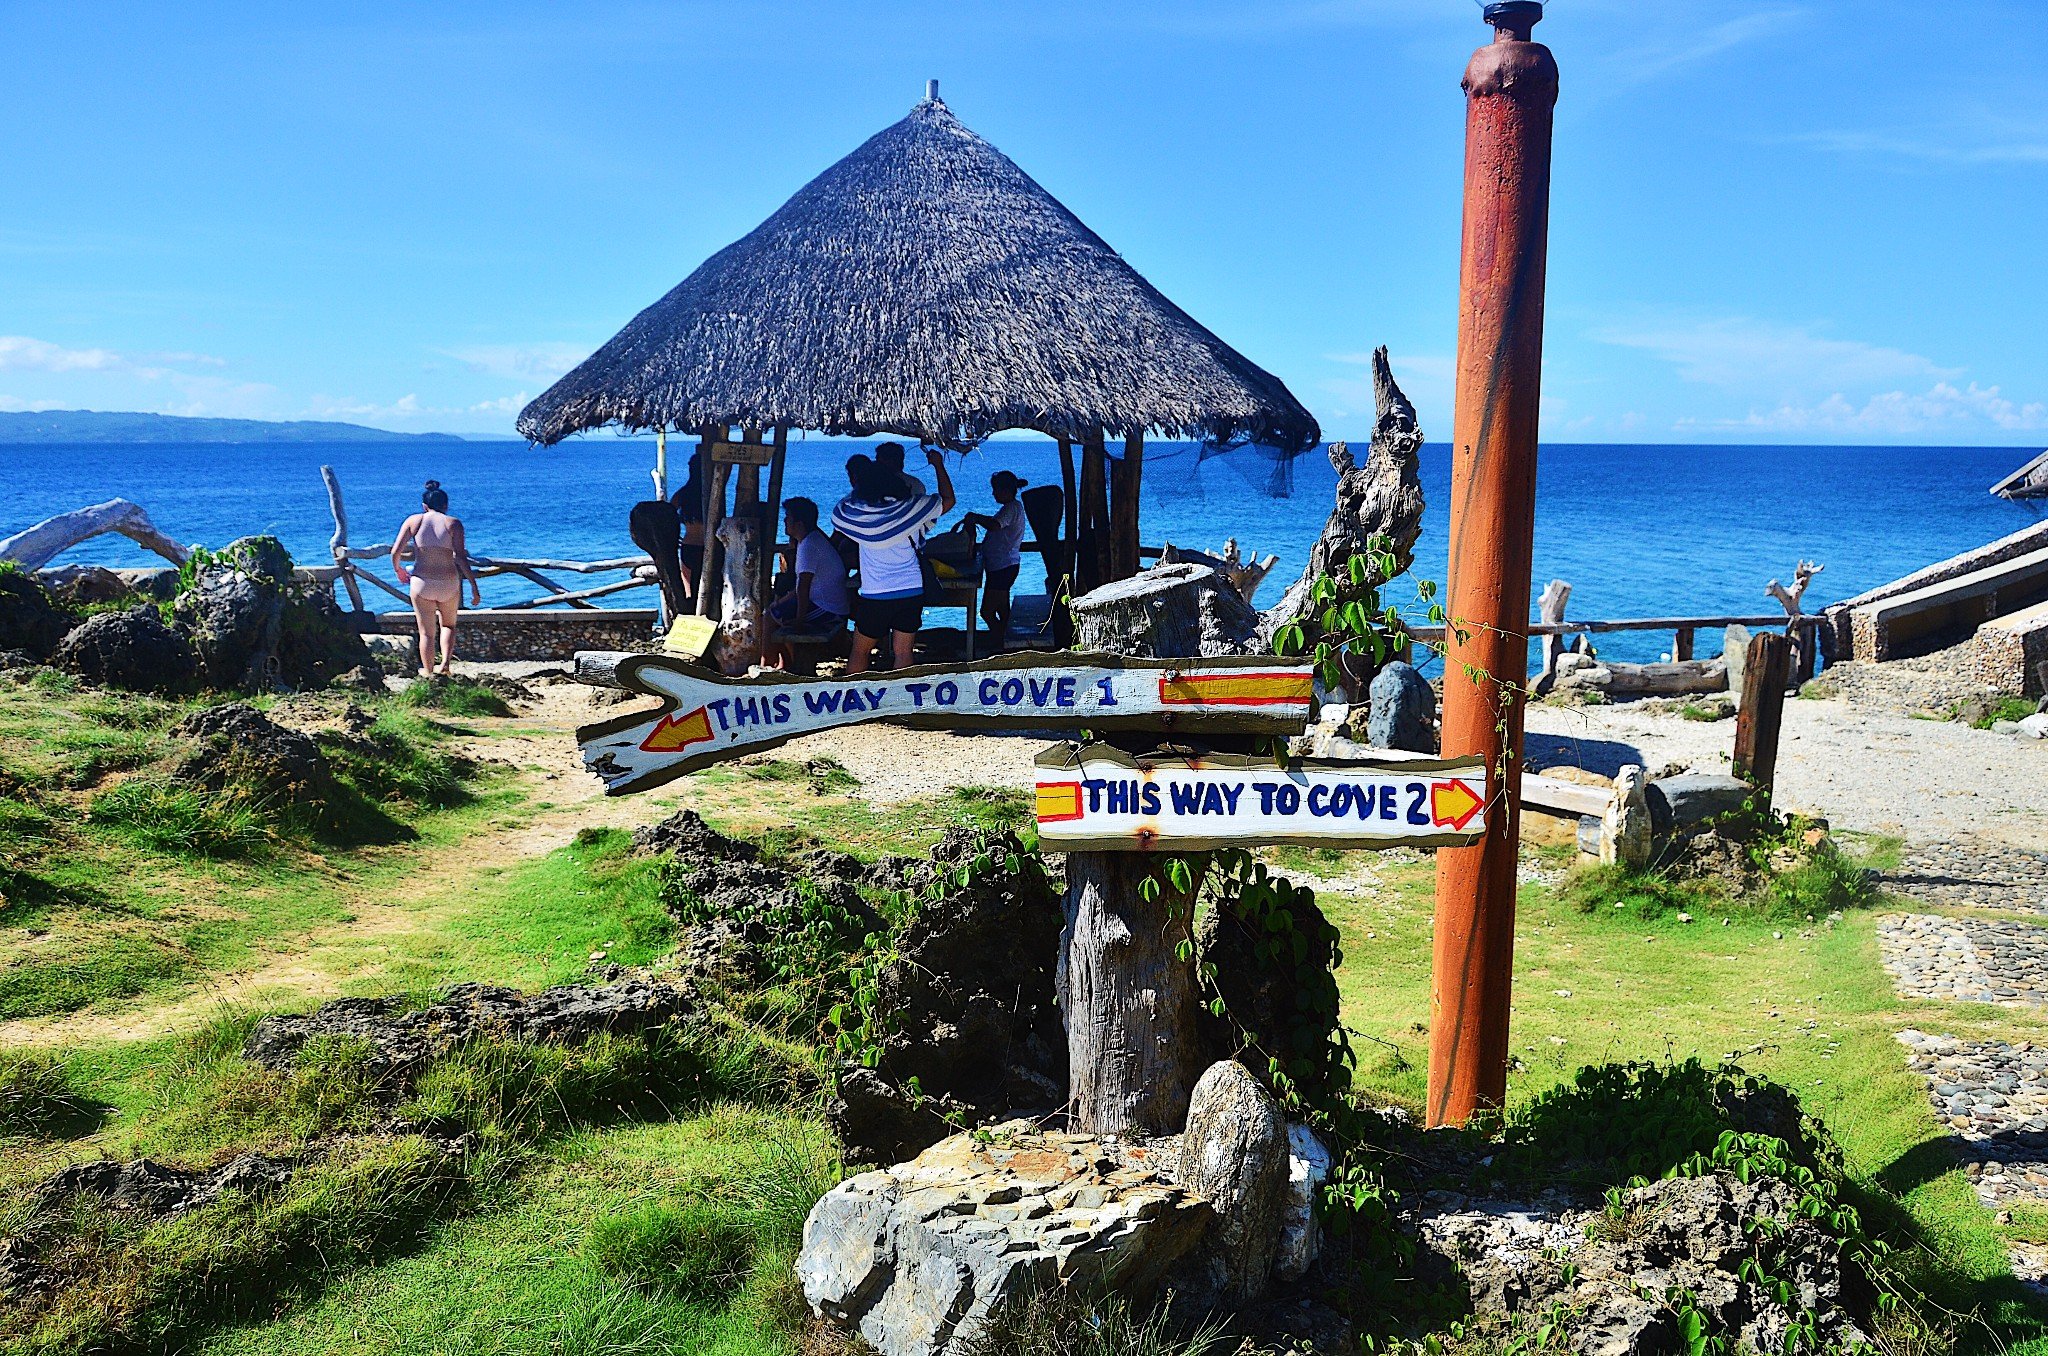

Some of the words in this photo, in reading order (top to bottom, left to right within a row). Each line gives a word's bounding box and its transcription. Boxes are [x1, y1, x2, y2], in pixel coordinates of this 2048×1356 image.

[707, 692, 791, 730] THIS
[803, 687, 887, 715] WAY
[905, 680, 959, 706] TO
[978, 676, 1077, 707] COVE
[1096, 676, 1118, 706] 1
[1081, 778, 1161, 816] THIS
[1169, 781, 1245, 816] WAY
[1252, 783, 1301, 816] TO
[1308, 783, 1398, 821] COVE
[1406, 782, 1430, 826] 2
